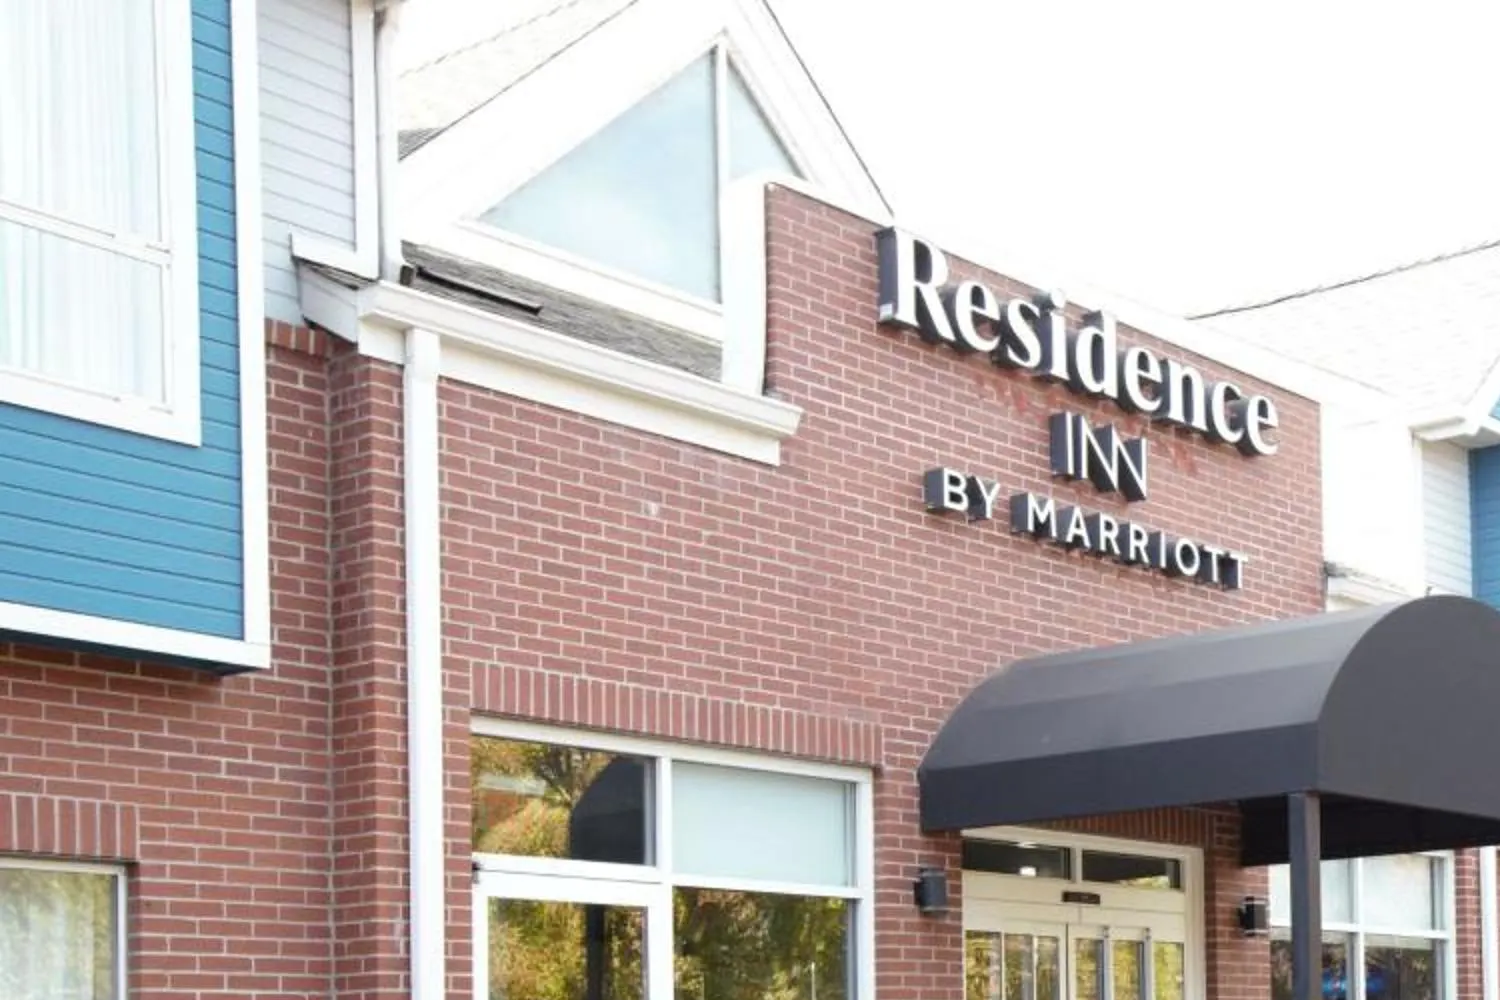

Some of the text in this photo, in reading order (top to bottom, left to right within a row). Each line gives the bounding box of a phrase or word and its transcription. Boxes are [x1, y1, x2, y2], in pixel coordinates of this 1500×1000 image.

[886, 226, 1279, 456] Residence
[1063, 410, 1148, 501] INN
[940, 467, 1249, 590] BY MARRIOTT
